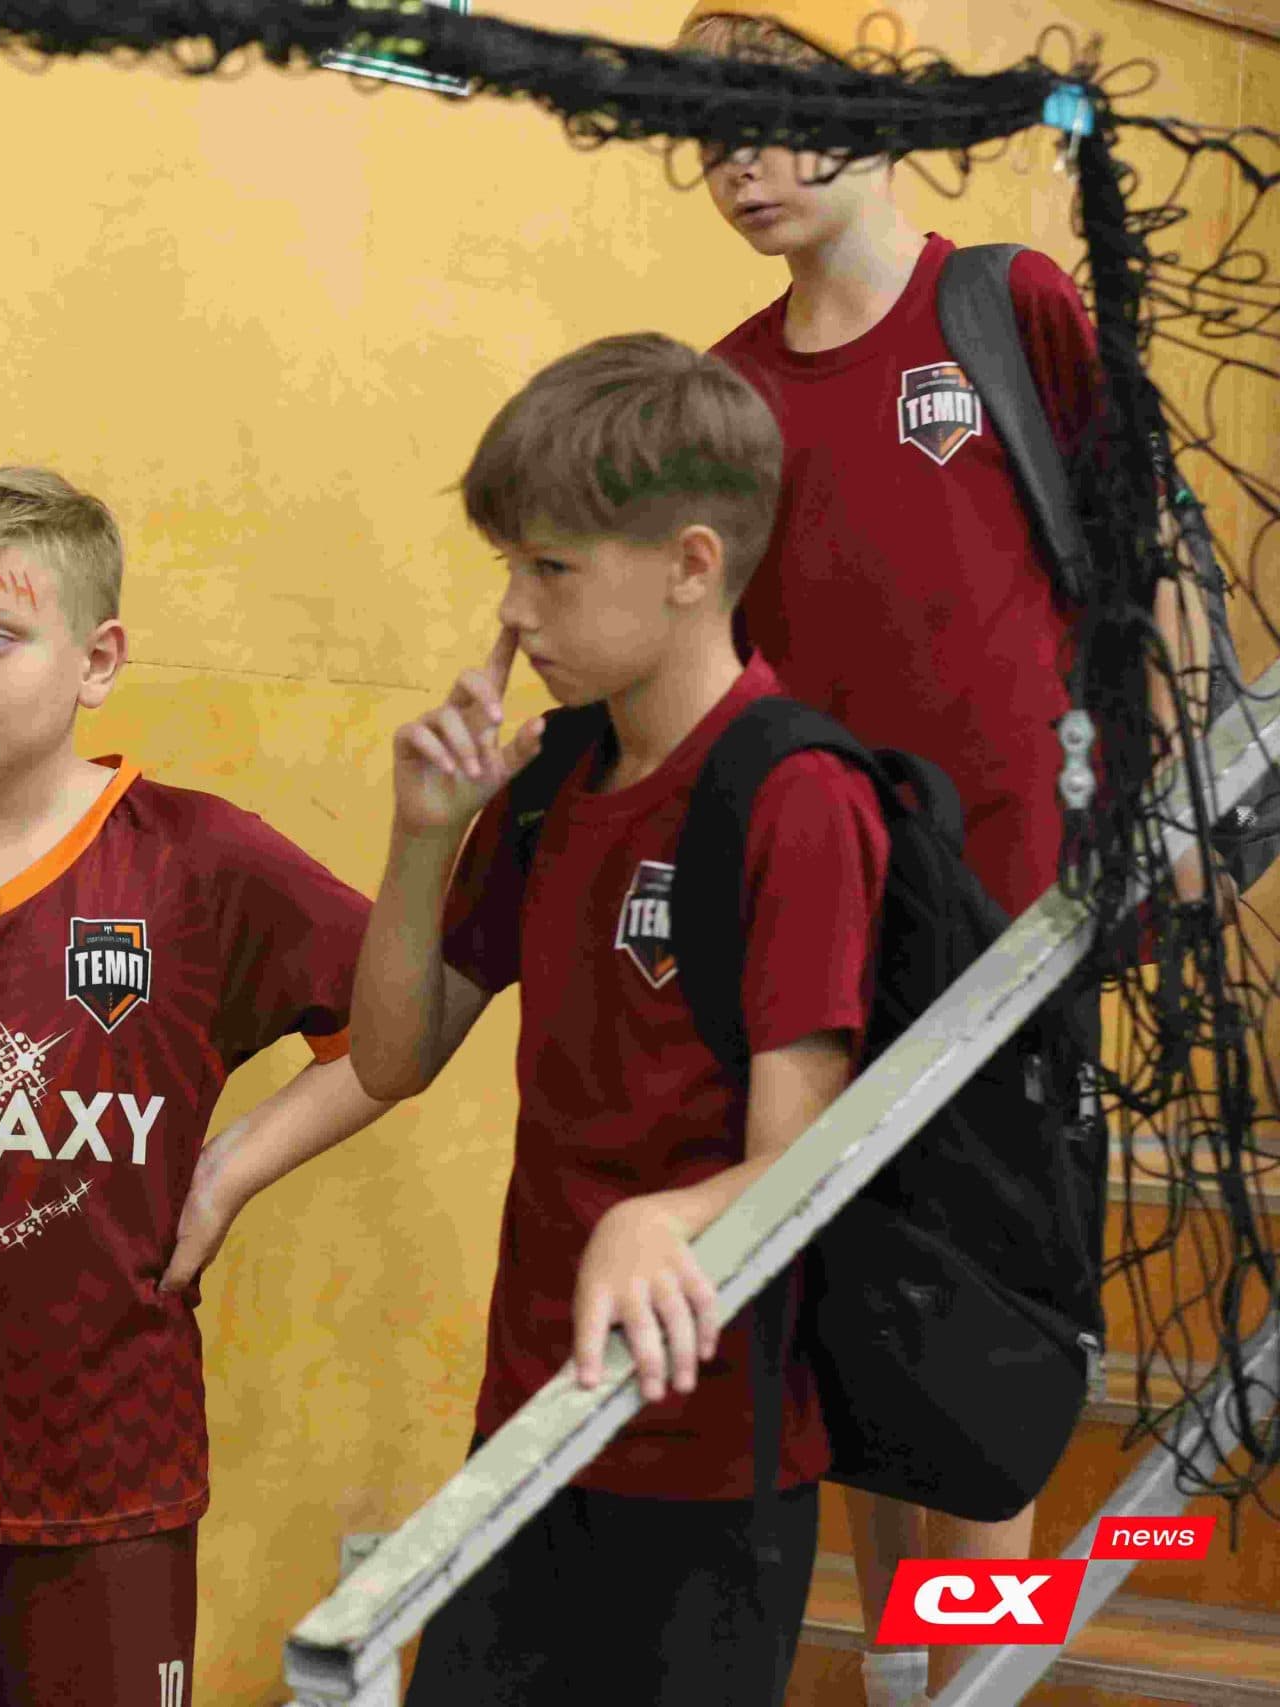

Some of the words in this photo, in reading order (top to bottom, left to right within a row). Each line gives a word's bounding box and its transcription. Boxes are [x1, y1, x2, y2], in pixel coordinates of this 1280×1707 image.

[906, 391, 972, 430] ТЕМП
[75, 950, 143, 990] ТЕМП
[158, 1659, 185, 1707] 10
